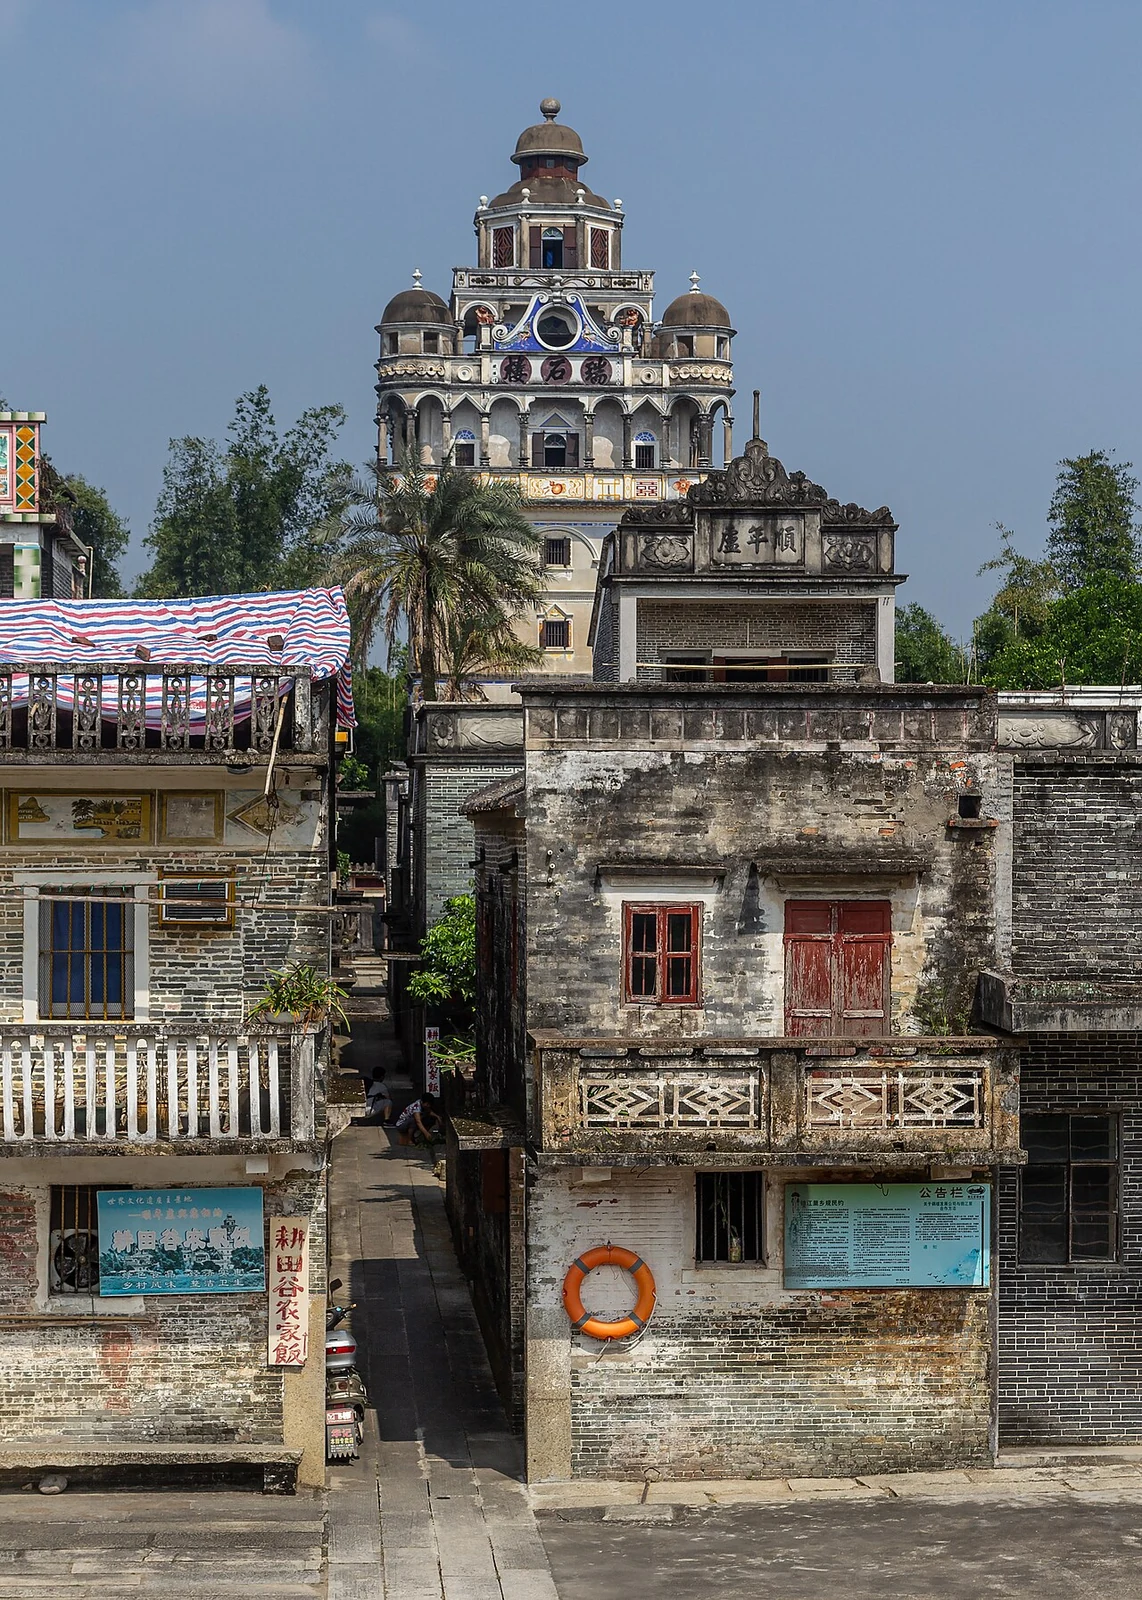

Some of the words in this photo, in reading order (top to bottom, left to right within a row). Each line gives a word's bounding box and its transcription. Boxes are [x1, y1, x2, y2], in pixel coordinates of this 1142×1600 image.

[919, 1186, 963, 1198] 公告栏
[122, 1281, 176, 1290] 乡村风味
[190, 1279, 244, 1288] 整洁卫生
